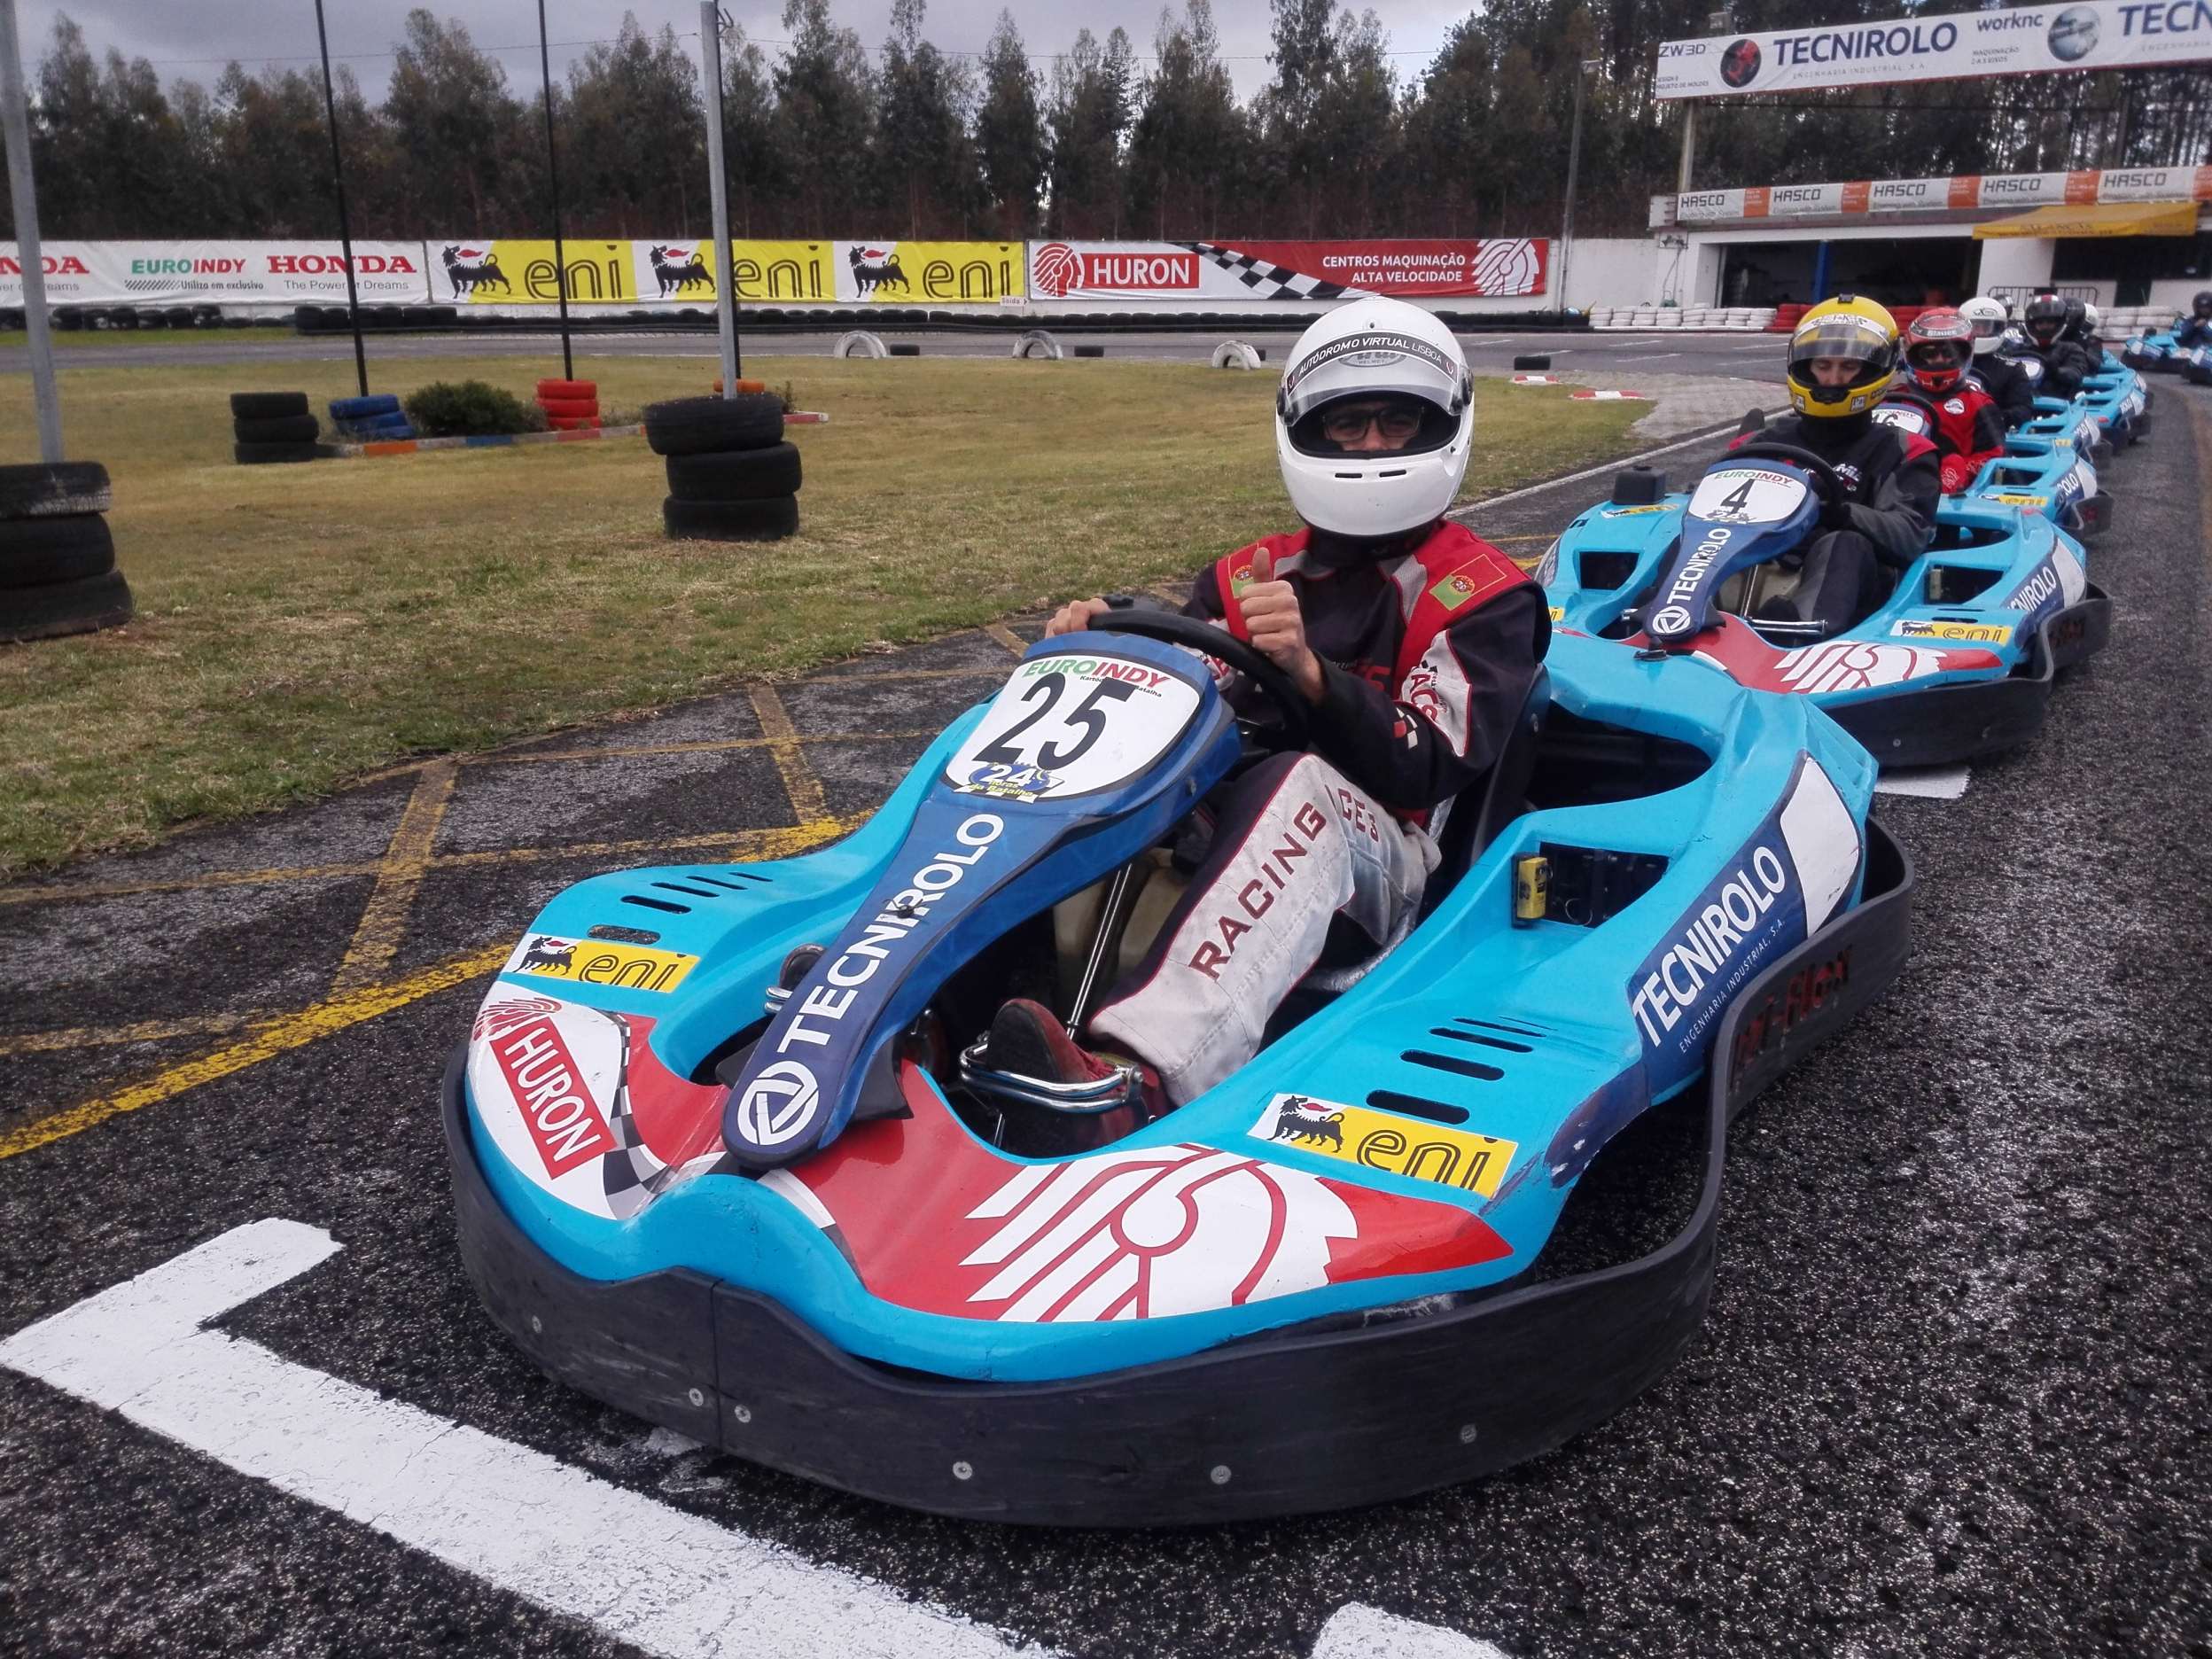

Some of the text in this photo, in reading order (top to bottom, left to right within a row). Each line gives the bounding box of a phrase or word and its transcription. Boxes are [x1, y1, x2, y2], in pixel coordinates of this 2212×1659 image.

[1977, 12, 2044, 33] worknc
[1772, 22, 1958, 66] TECNIROLO
[1873, 183, 1926, 198] HASCO
[1983, 178, 2042, 193] HASCO
[2104, 173, 2168, 188] HASCO
[1681, 194, 1725, 208] HASCO
[1773, 189, 1821, 203] HASCO
[131, 258, 246, 275] EUROINDY
[267, 254, 417, 274] HONDA
[525, 244, 621, 300] eni
[734, 245, 822, 299] eni
[923, 245, 1009, 299] eni
[1094, 257, 1190, 286] HURON
[1323, 252, 1467, 269] CENTROS MAQUINAÇÃO
[211, 282, 225, 291] em
[226, 279, 264, 291] exclusivo
[284, 279, 307, 290] The
[310, 279, 345, 290] Power
[363, 279, 409, 290] Dreams
[1351, 269, 1463, 284] ALTA VELOCIDADE
[1298, 336, 1443, 376] AUTÓDROMO VIRTUAL LISBOA
[1714, 471, 1794, 485] EUROINDY
[1720, 478, 1756, 515] 4
[1666, 528, 1732, 604] TECNIROLO
[1943, 625, 2003, 643] eni
[1022, 658, 1171, 689] EUROINDY
[972, 672, 1139, 771] 25
[978, 763, 1037, 787] 24
[986, 784, 1034, 798] Batalha
[1188, 801, 1327, 979] RACING
[777, 814, 1004, 1054] TECNIROLO
[1632, 846, 1786, 1048] TECNIROLO
[579, 954, 687, 992] eni
[1678, 990, 1728, 1054] ENGENHARIA
[504, 1027, 602, 1163] HURON
[1356, 1129, 1499, 1191] eni
